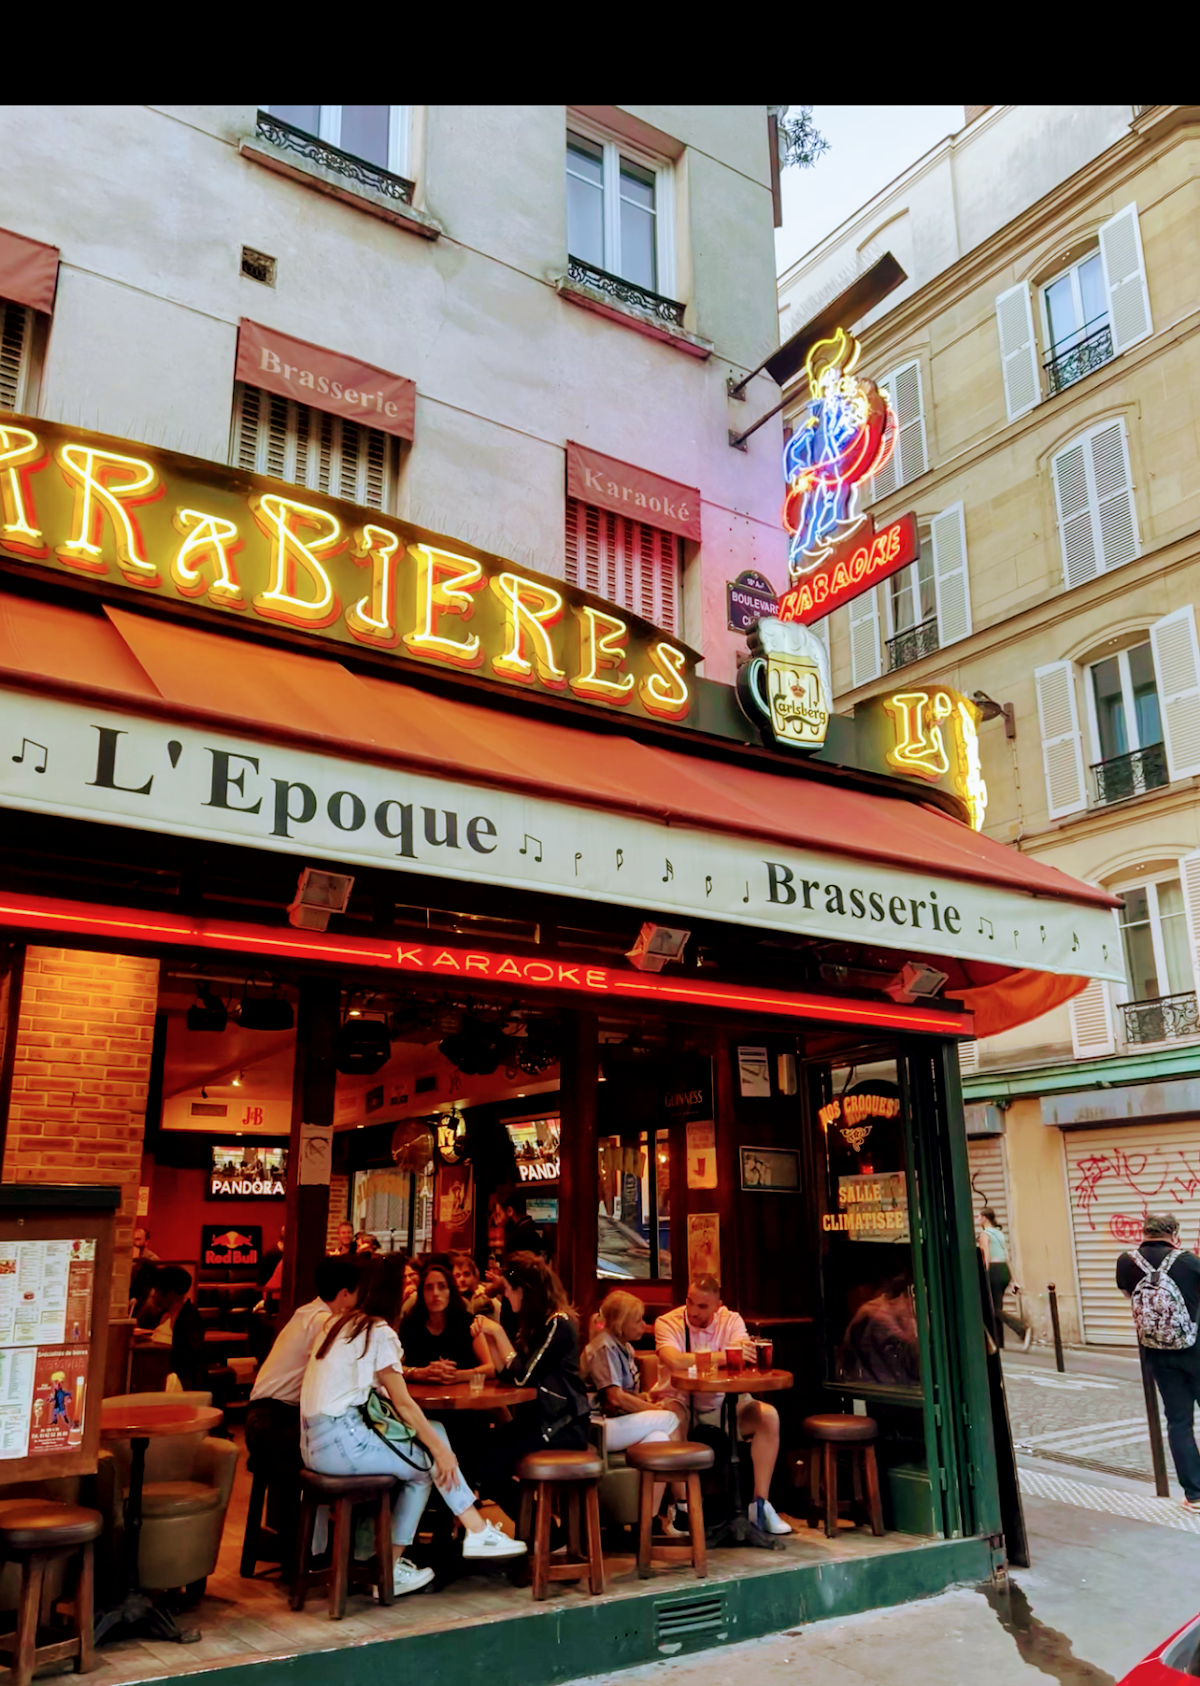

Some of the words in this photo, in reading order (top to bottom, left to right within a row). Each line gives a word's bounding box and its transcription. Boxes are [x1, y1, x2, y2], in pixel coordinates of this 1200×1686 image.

[257, 347, 399, 418] Brasserie
[584, 467, 690, 522] Karaoké
[773, 693, 826, 725] Carlsberg
[85, 723, 499, 859] L'Epoque
[761, 860, 963, 935] Brasserie
[396, 946, 608, 989] KARAOKE
[211, 1179, 285, 1195] PANDORA
[838, 1183, 882, 1204] SALLE
[822, 1211, 904, 1232] CLIMATISEE
[205, 1249, 232, 1265] Red
[232, 1249, 257, 1265] Bull
